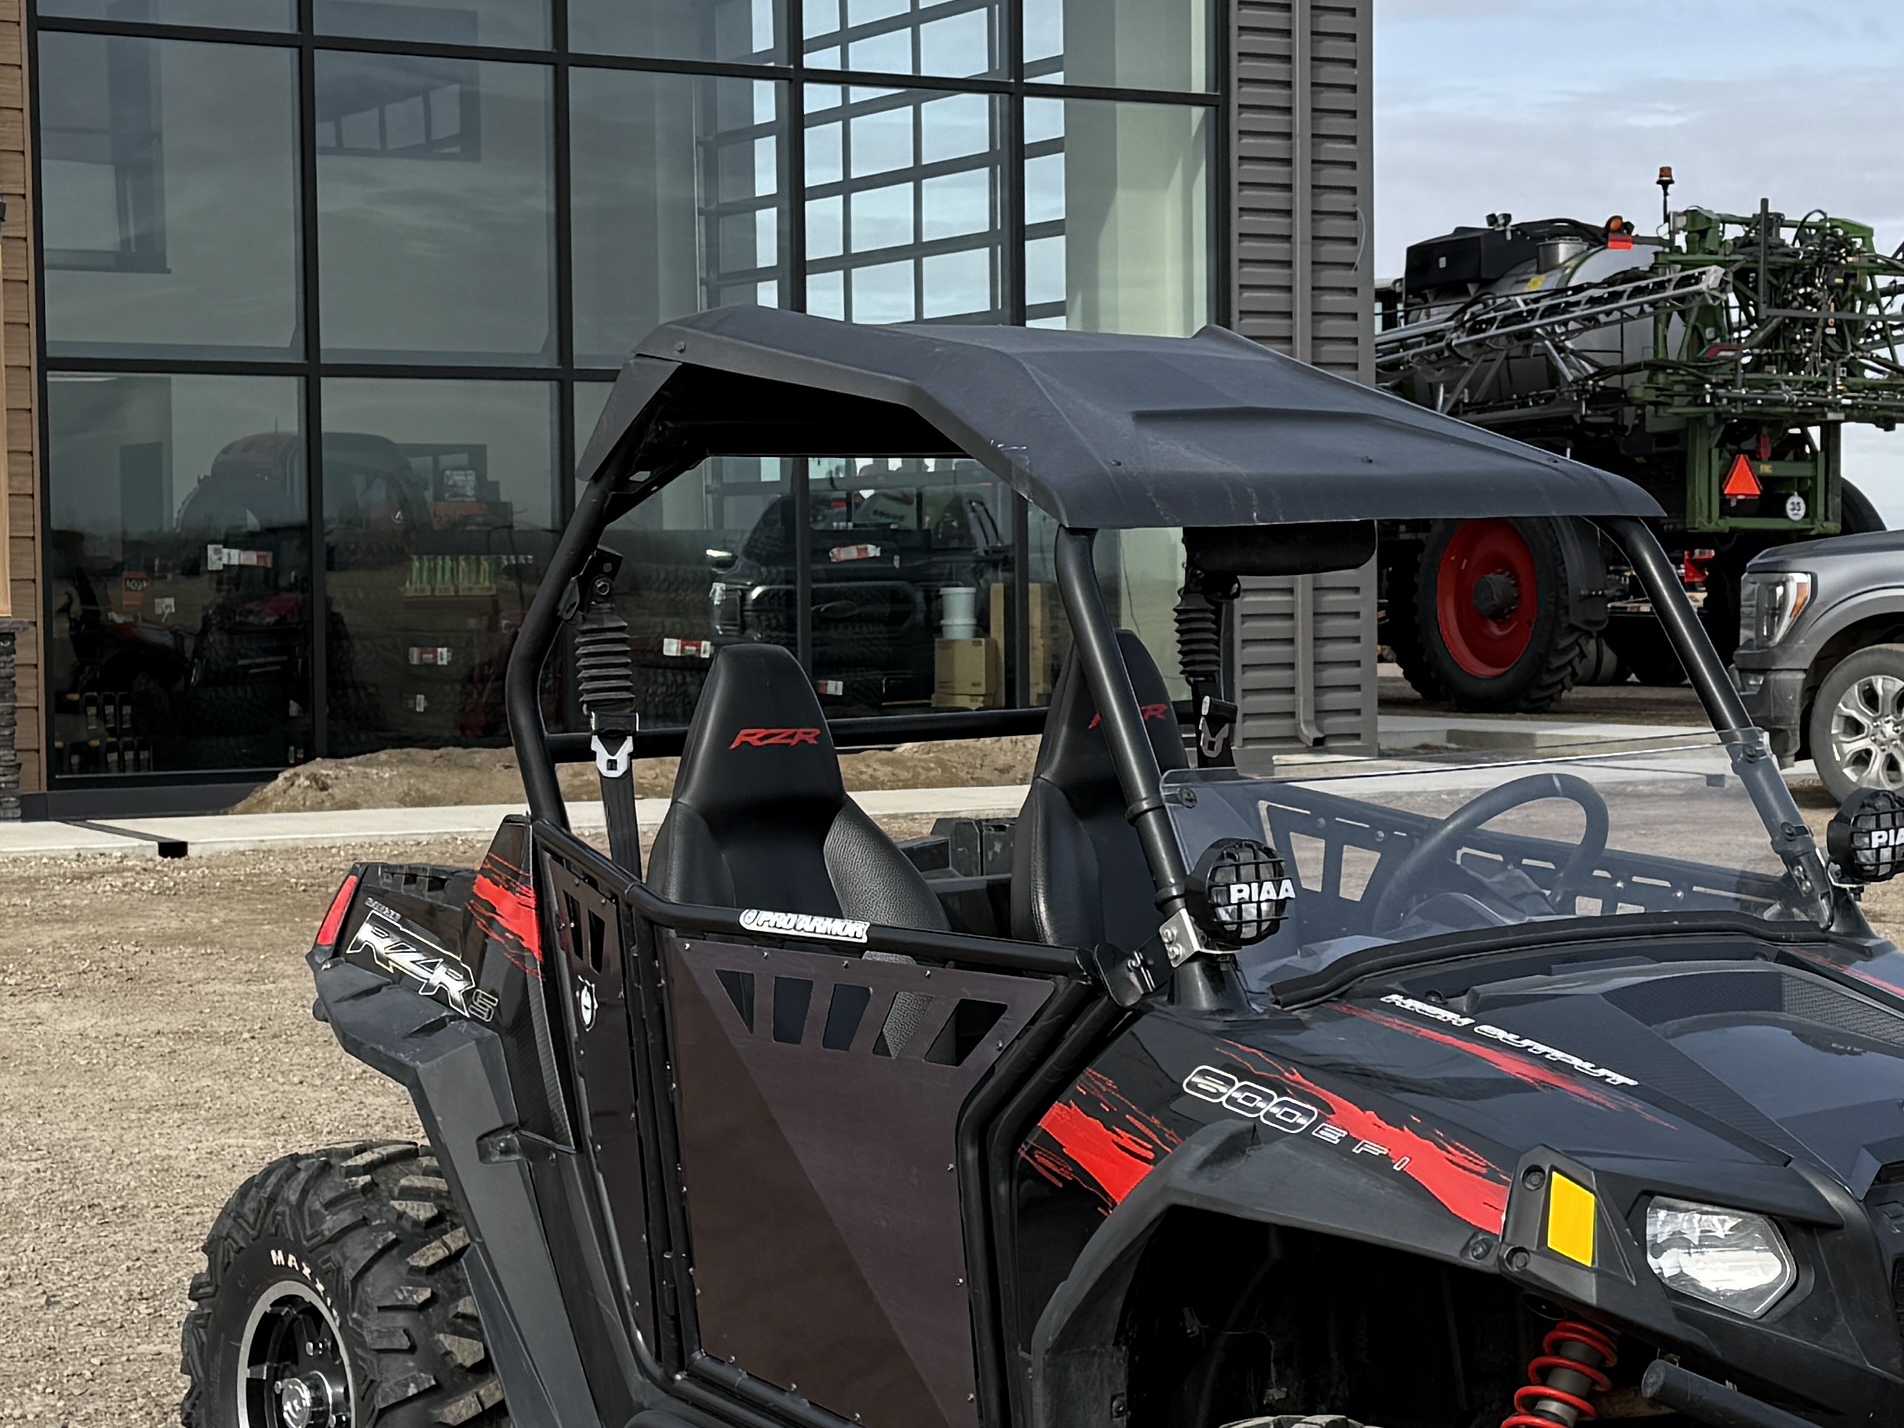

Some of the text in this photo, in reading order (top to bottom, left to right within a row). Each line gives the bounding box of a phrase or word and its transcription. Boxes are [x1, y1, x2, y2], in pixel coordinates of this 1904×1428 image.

[729, 728, 821, 750] RZR
[1229, 878, 1296, 904] PIAA
[757, 909, 866, 939] PRO ARMOR
[346, 909, 476, 1019] RZR
[1473, 1024, 1639, 1086] OUTPUT
